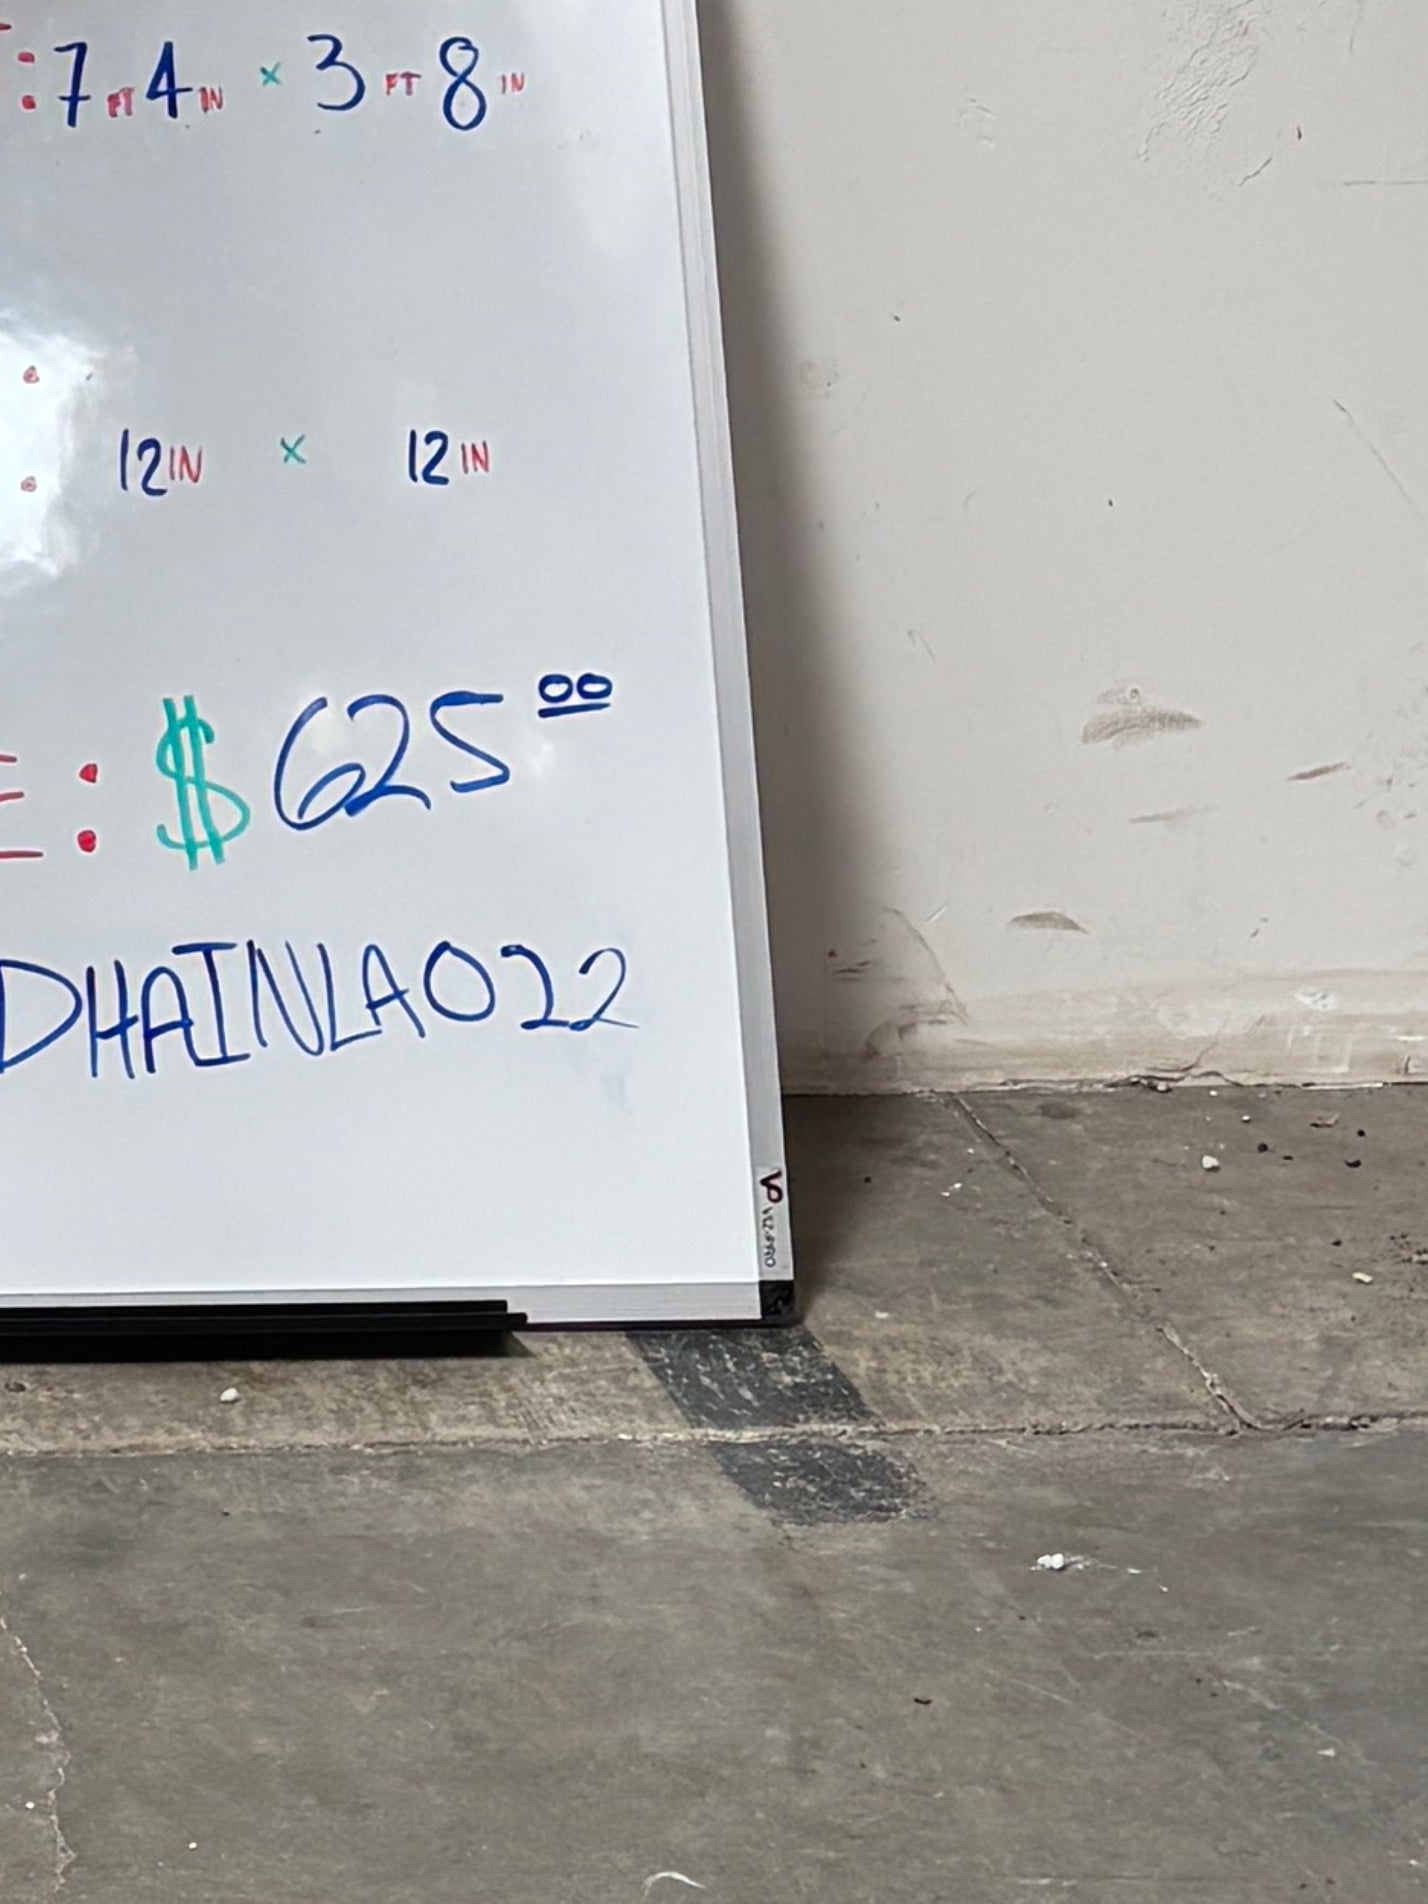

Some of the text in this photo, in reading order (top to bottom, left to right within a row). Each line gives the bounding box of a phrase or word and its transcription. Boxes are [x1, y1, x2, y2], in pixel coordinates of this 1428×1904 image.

[53, 42, 88, 128] 7
[144, 41, 194, 119] 4
[307, 33, 367, 113] 3
[439, 36, 488, 132] 8
